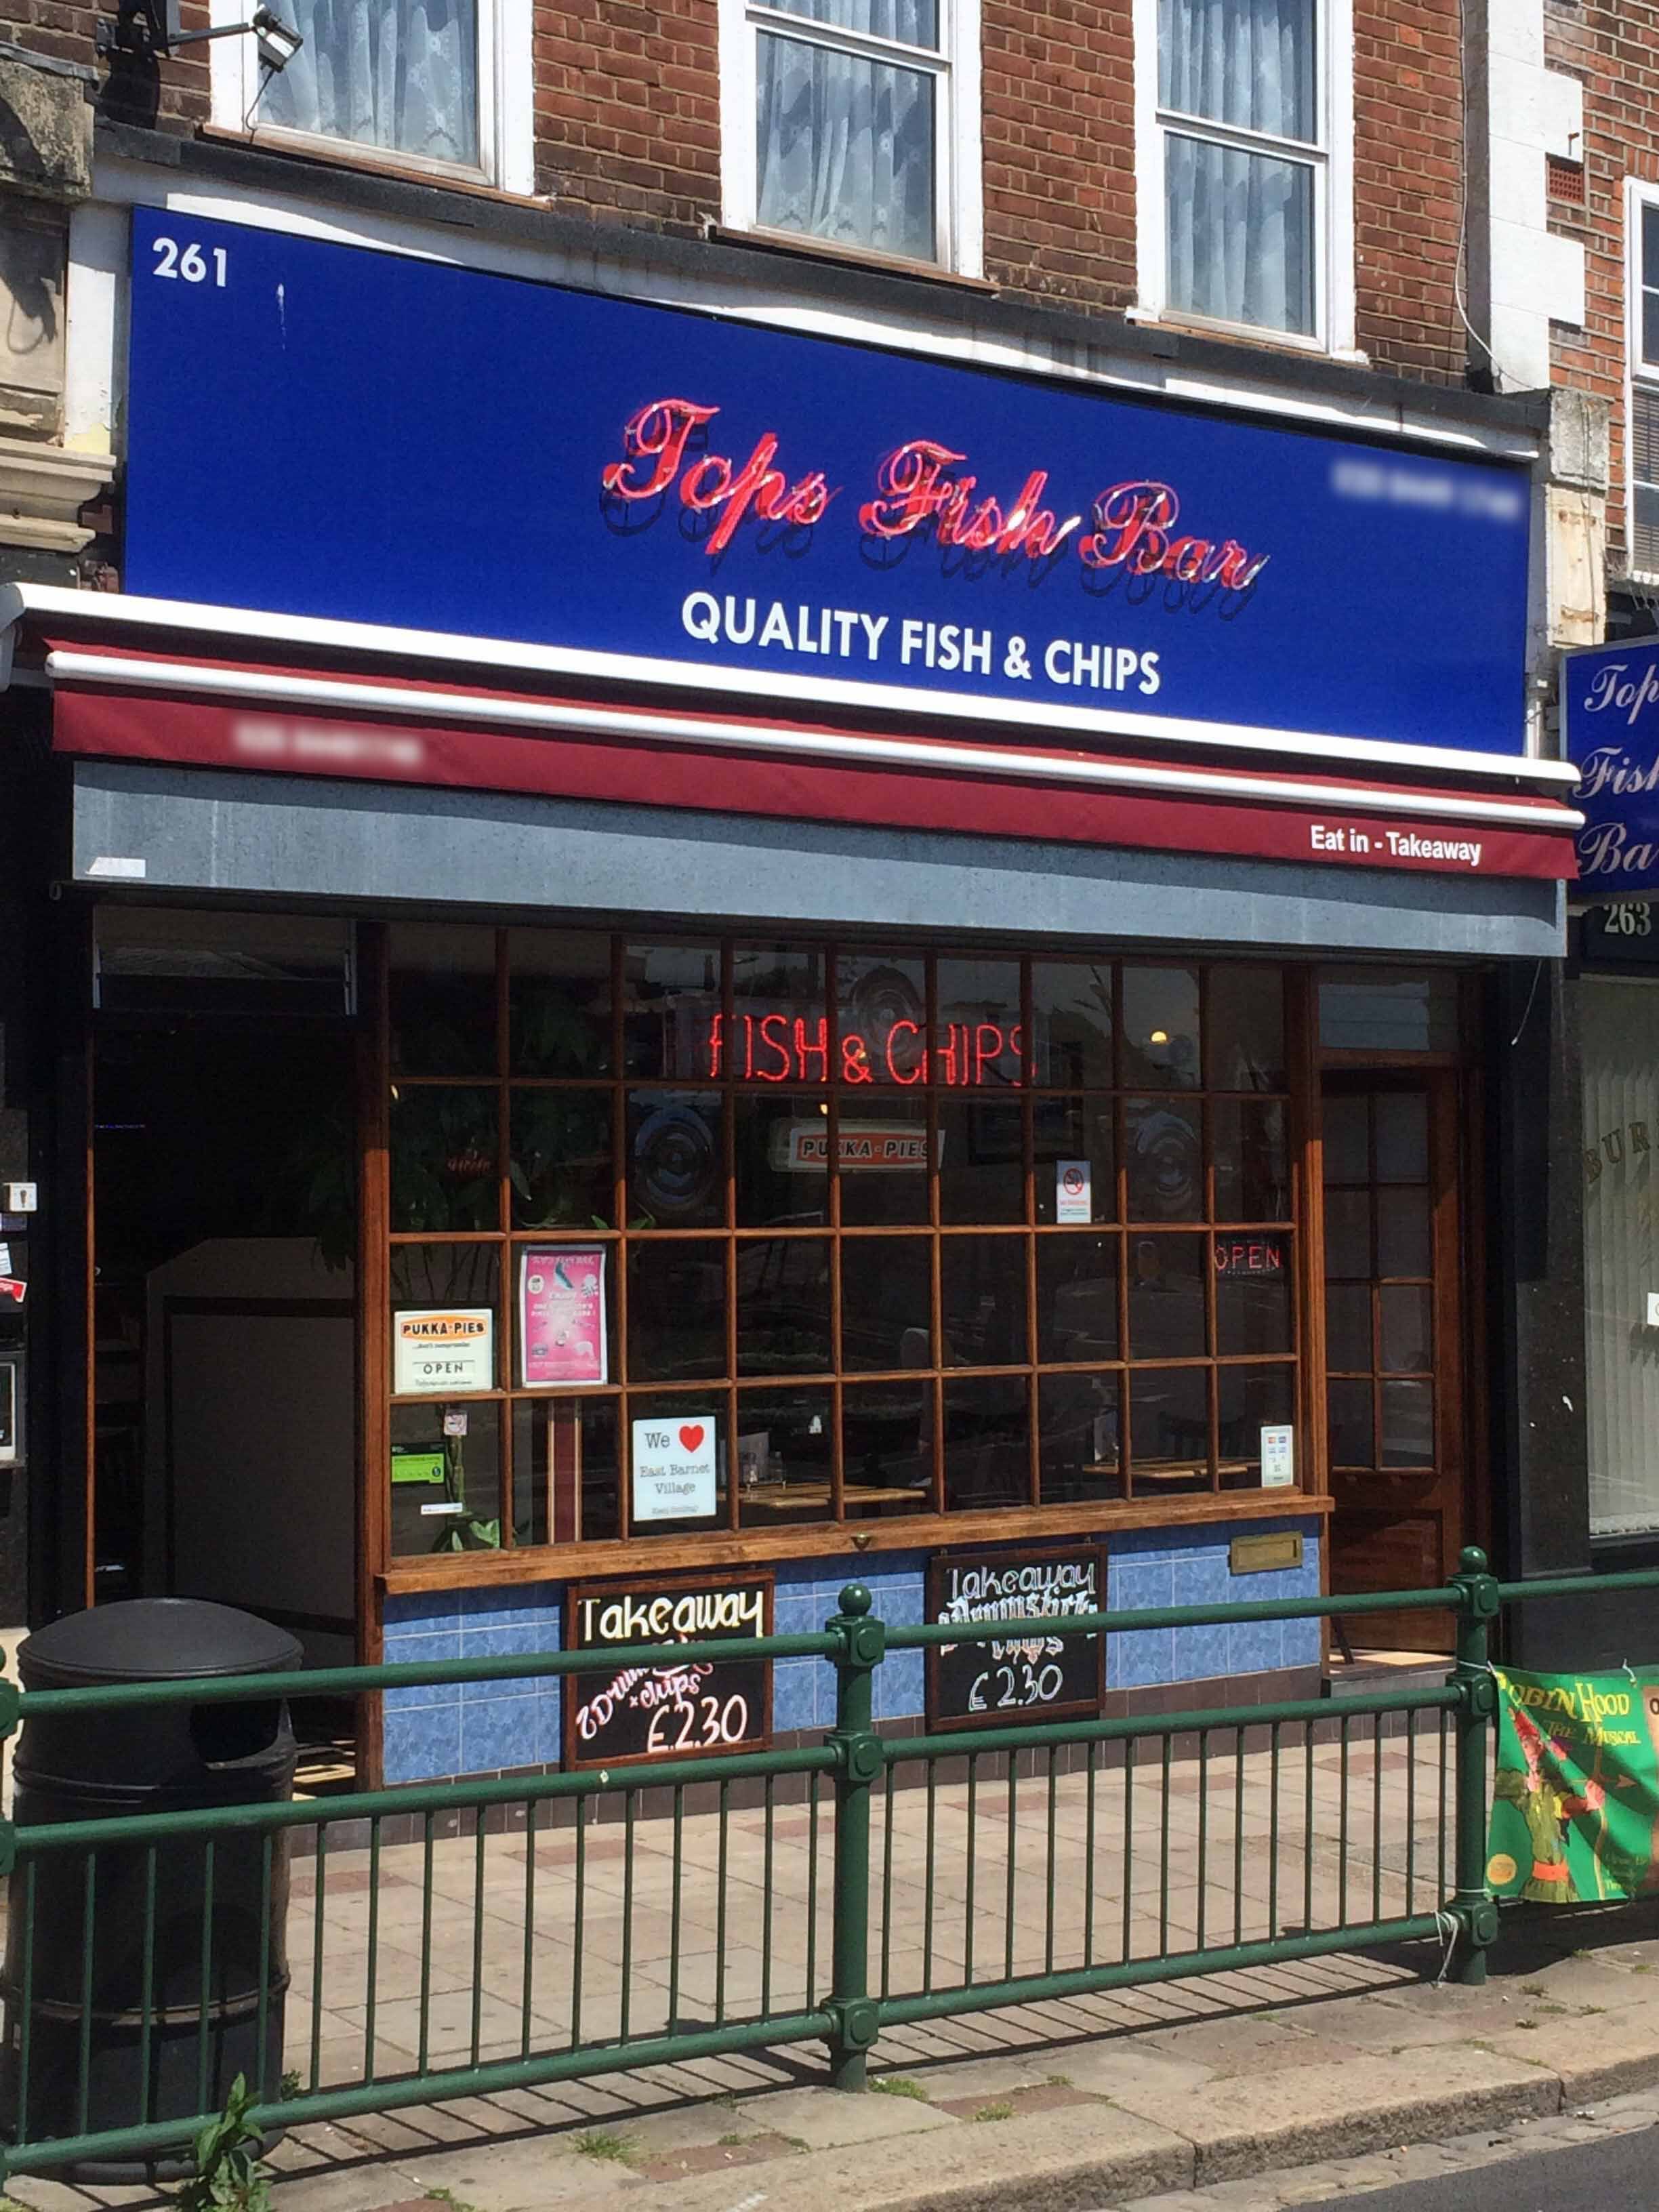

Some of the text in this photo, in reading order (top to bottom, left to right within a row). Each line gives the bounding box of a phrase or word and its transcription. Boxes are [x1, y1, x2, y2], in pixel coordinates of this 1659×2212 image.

[152, 237, 227, 287] 261
[600, 398, 840, 555] Tops
[859, 441, 1081, 557] Fish
[1078, 480, 1271, 590] Bar
[682, 591, 1161, 695] QUALITY FISH & CHIPS
[1311, 825, 1345, 851] Eat
[1349, 828, 1369, 853] in
[1385, 831, 1482, 867] Takeaway
[1603, 902, 1652, 936] 263
[709, 1013, 828, 1082] FISH
[842, 1035, 873, 1083] &
[802, 1138, 872, 1159] PUKA
[1583, 1121, 1659, 1183] BUR
[1214, 1246, 1281, 1271] OPEN
[403, 1322, 484, 1334] PUKKA PIES
[423, 1362, 464, 1374] OPEN
[645, 1432, 670, 1449] We
[640, 1464, 710, 1477] East Barnet
[655, 1481, 696, 1495] Village
[946, 1563, 1097, 1600] Takeaway
[577, 1591, 764, 1642] Takeaway
[1496, 1672, 1577, 1720] OBIN
